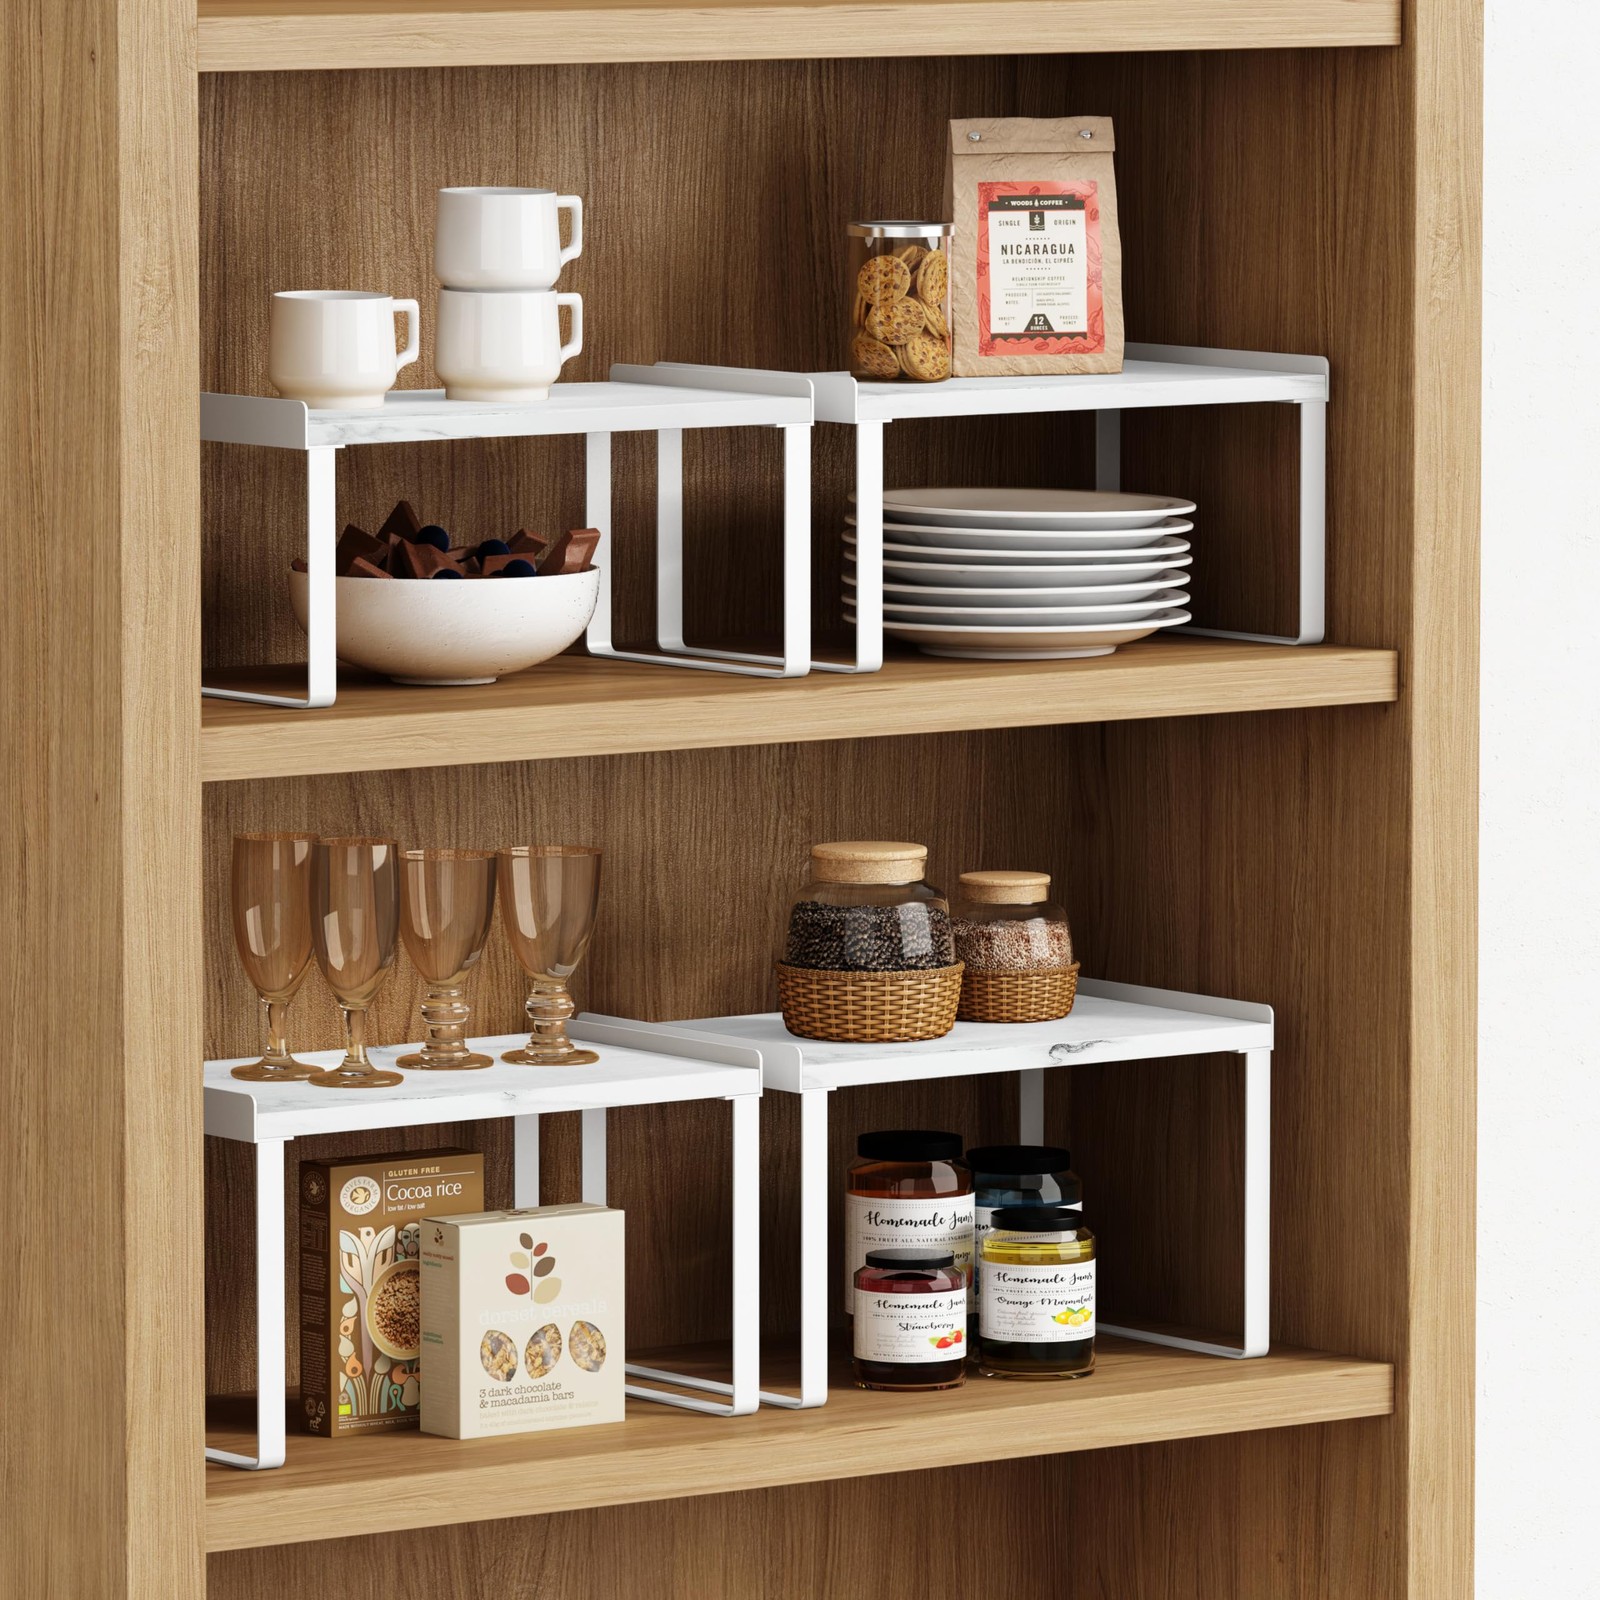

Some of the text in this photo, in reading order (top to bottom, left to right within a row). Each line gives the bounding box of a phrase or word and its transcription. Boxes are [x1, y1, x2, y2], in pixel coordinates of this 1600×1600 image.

[1001, 244, 1075, 255] NICARAGUA
[1034, 316, 1045, 325] 12
[388, 1166, 440, 1177] GLUTEN FREE
[387, 1180, 462, 1201] Cocoa rice
[864, 1210, 973, 1230] Homemade Jams
[994, 1272, 1092, 1285] Homemade Jams
[873, 1300, 944, 1310] Homemade
[995, 1294, 1093, 1308] Orange Marmalade
[480, 1298, 607, 1324] dorset cereals
[896, 1322, 954, 1332] Strawberry
[480, 1382, 561, 1398] 3 dark chocolate
[480, 1392, 575, 1408] & macadamia bars
